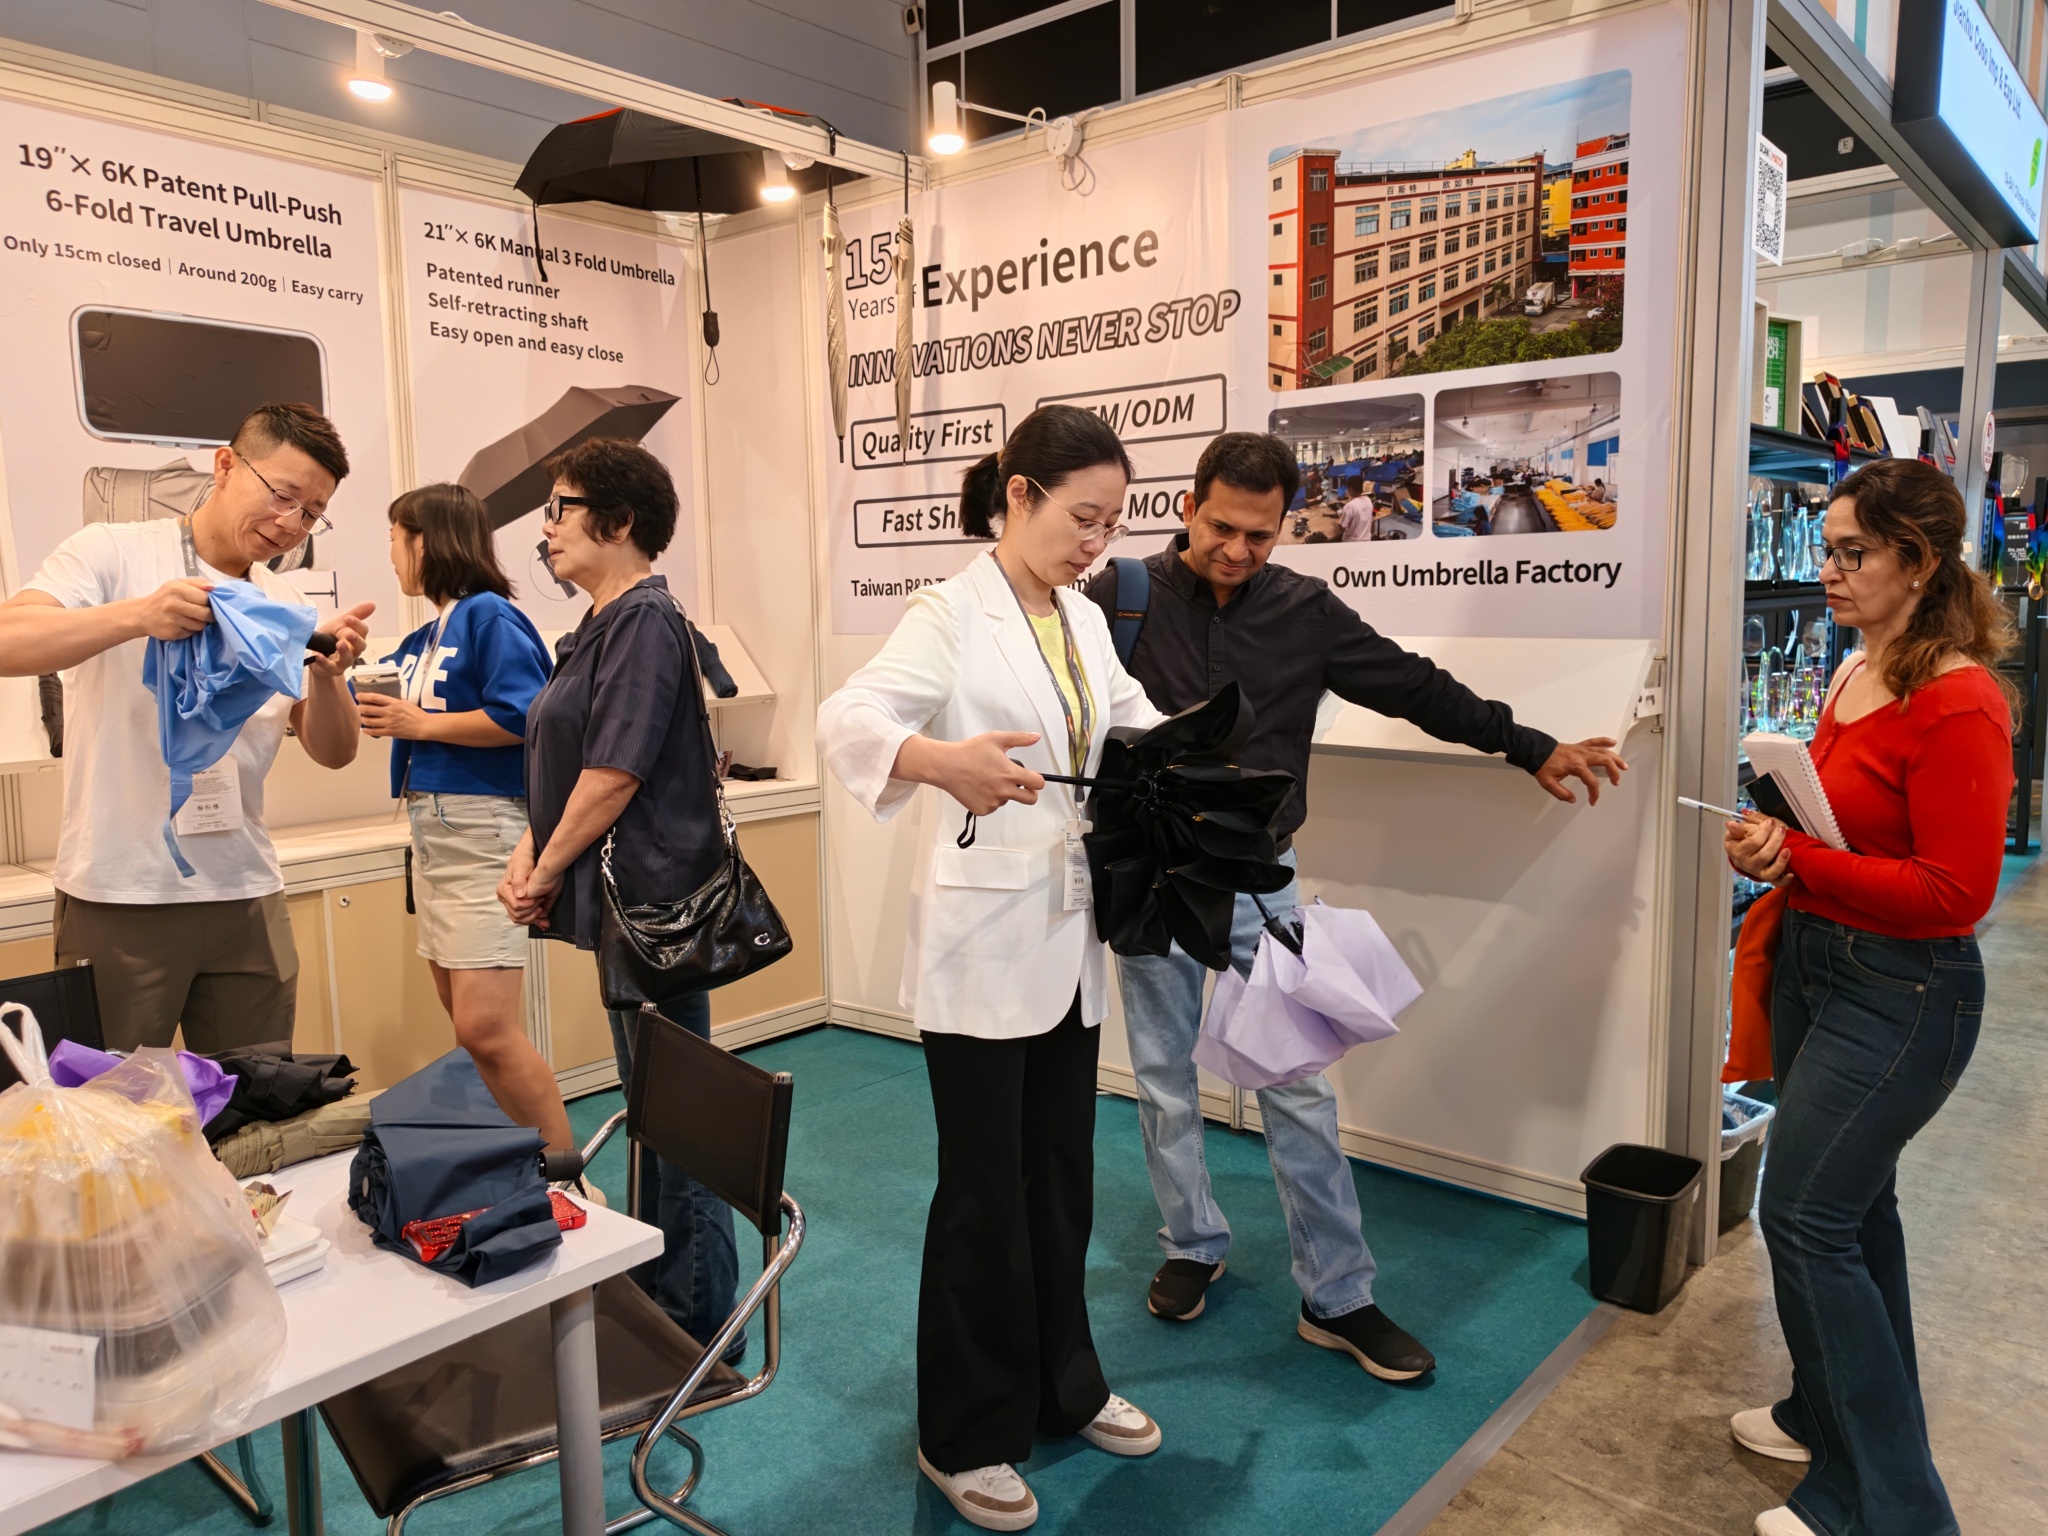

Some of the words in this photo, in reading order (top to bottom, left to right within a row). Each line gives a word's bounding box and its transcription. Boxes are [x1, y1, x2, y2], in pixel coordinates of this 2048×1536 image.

[1988, 47, 1999, 86] Imp
[1998, 66, 2004, 92] &
[2003, 73, 2013, 109] Exp
[101, 159, 138, 187] 6K
[143, 166, 228, 205] Patent
[233, 185, 343, 226] Pull-Push
[45, 188, 134, 225] 6-Fold
[139, 204, 221, 240] Travel
[225, 219, 333, 259] Umbrella
[3, 234, 49, 258] Only
[54, 241, 102, 263] 15cm
[106, 250, 162, 272] closed
[178, 261, 237, 284] Around
[239, 270, 278, 293] 200g
[291, 279, 324, 300] Easy
[327, 287, 364, 306] carry
[474, 231, 498, 252] 6K
[562, 249, 572, 265] 3
[574, 251, 607, 273] Fold
[610, 258, 676, 287] Umbrella
[845, 231, 900, 291] 15
[921, 229, 1160, 313] Experience
[426, 262, 504, 290] Patented
[507, 277, 561, 300] runner
[427, 291, 549, 329] Self-retracting
[550, 310, 590, 332] shaft
[847, 295, 896, 321] Years
[429, 320, 469, 344] Easy
[473, 330, 514, 348] open
[517, 334, 547, 352] and
[550, 341, 584, 361] easy
[587, 346, 624, 363] close
[847, 325, 1034, 388] INNVATIONS
[1036, 307, 1143, 361] NEVER
[1144, 288, 1242, 344] STOP
[1083, 393, 1195, 436] M/ODM
[862, 424, 936, 461] Quaity
[941, 418, 994, 447] First
[882, 508, 924, 533] Fast
[850, 578, 903, 597] Taiwan
[1332, 565, 1387, 588] Own
[1392, 559, 1509, 587] Umbrella
[1515, 559, 1623, 589] Factory
